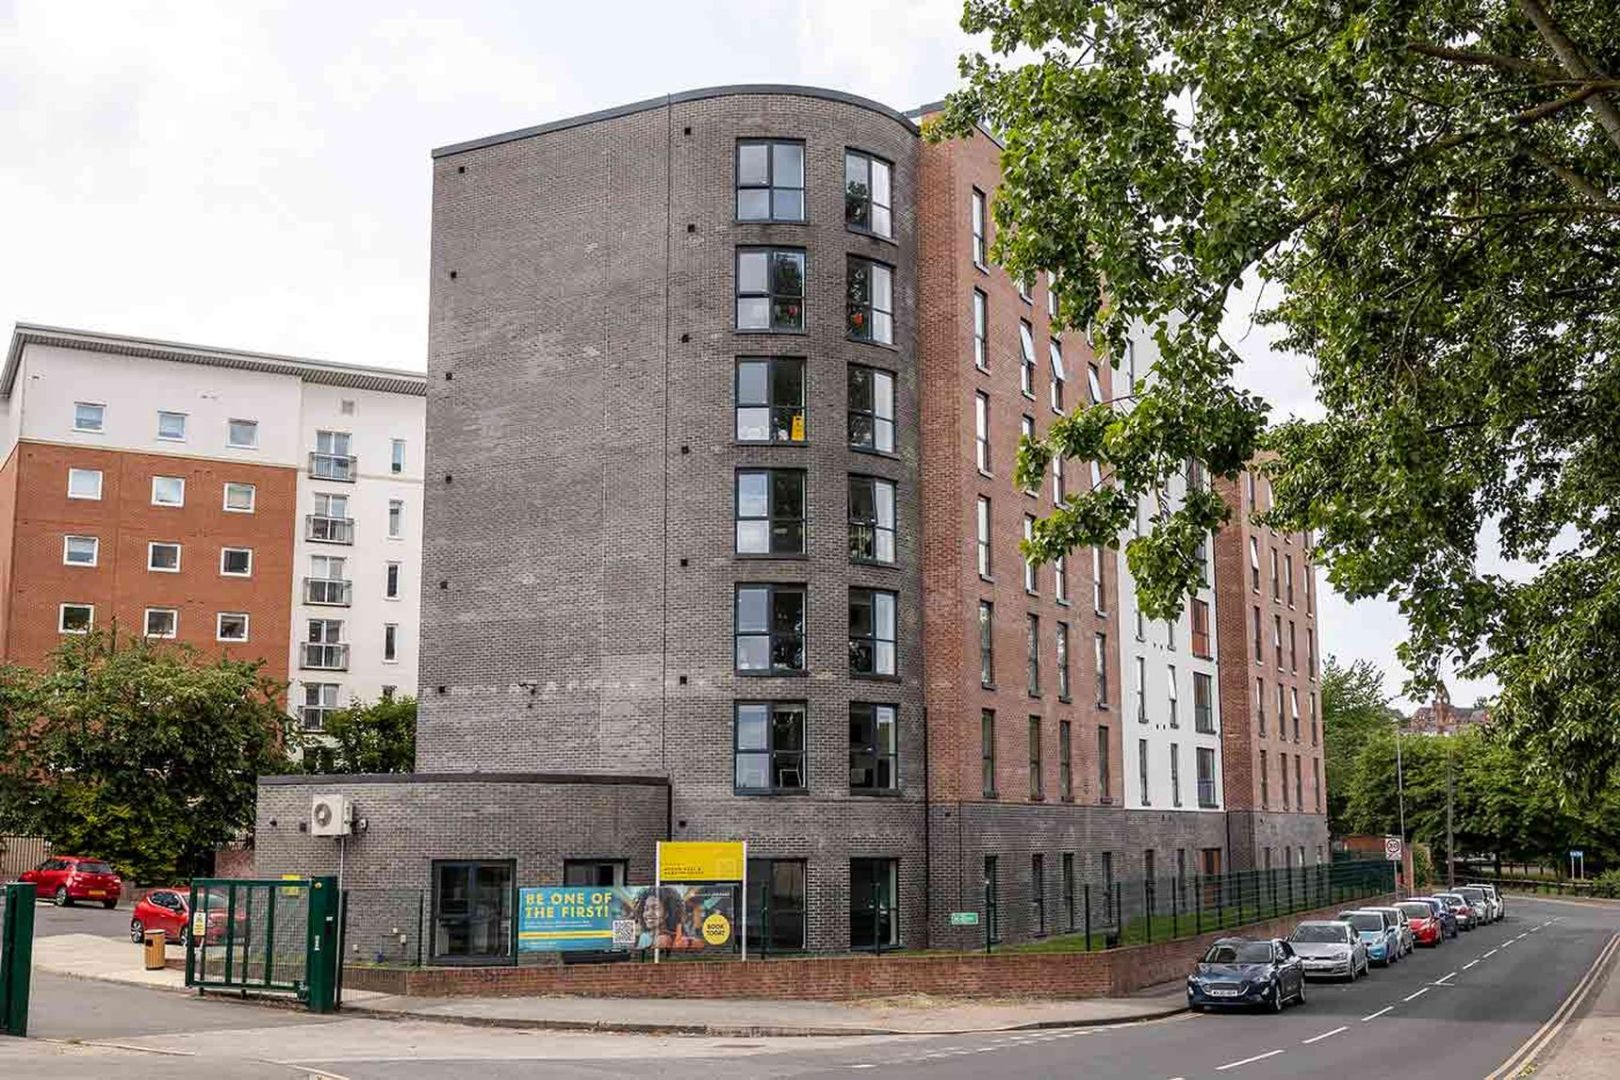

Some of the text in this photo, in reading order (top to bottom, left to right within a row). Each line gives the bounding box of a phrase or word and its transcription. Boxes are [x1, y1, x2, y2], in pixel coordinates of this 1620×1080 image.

[526, 892, 613, 905] BE ONE OF
[525, 905, 609, 918] THE FIRST!
